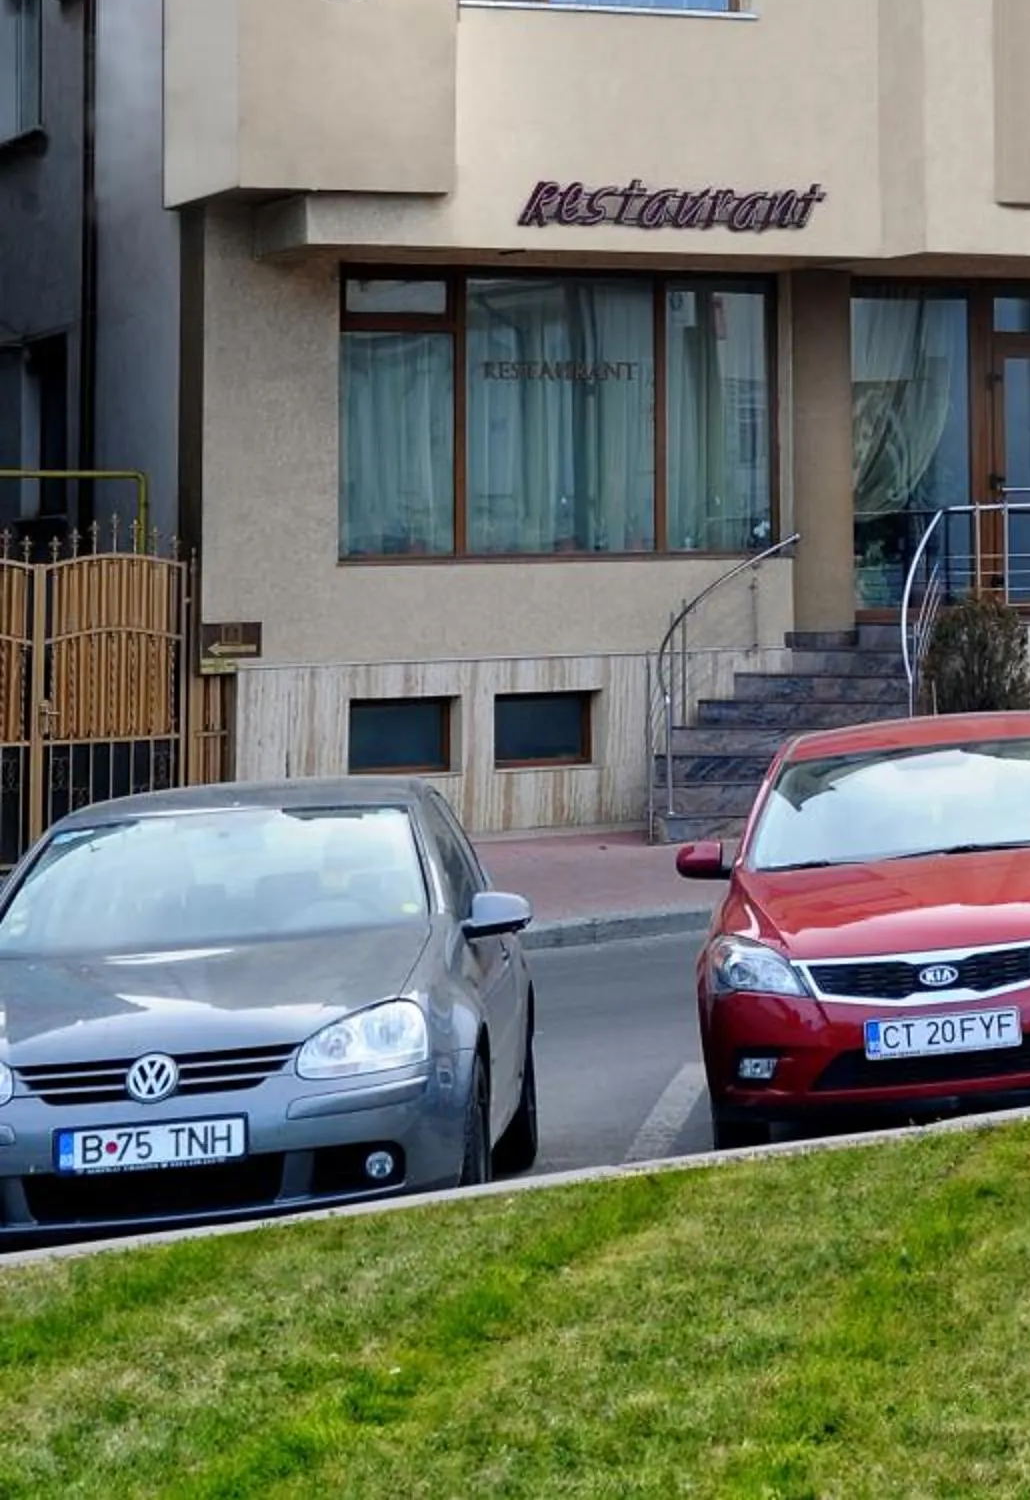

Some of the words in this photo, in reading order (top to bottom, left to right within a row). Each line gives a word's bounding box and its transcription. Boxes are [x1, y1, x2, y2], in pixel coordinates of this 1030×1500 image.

[483, 359, 638, 381] RESTAURANT
[923, 966, 953, 984] KIA
[882, 1022, 916, 1049] CT
[168, 1123, 233, 1158] TNH
